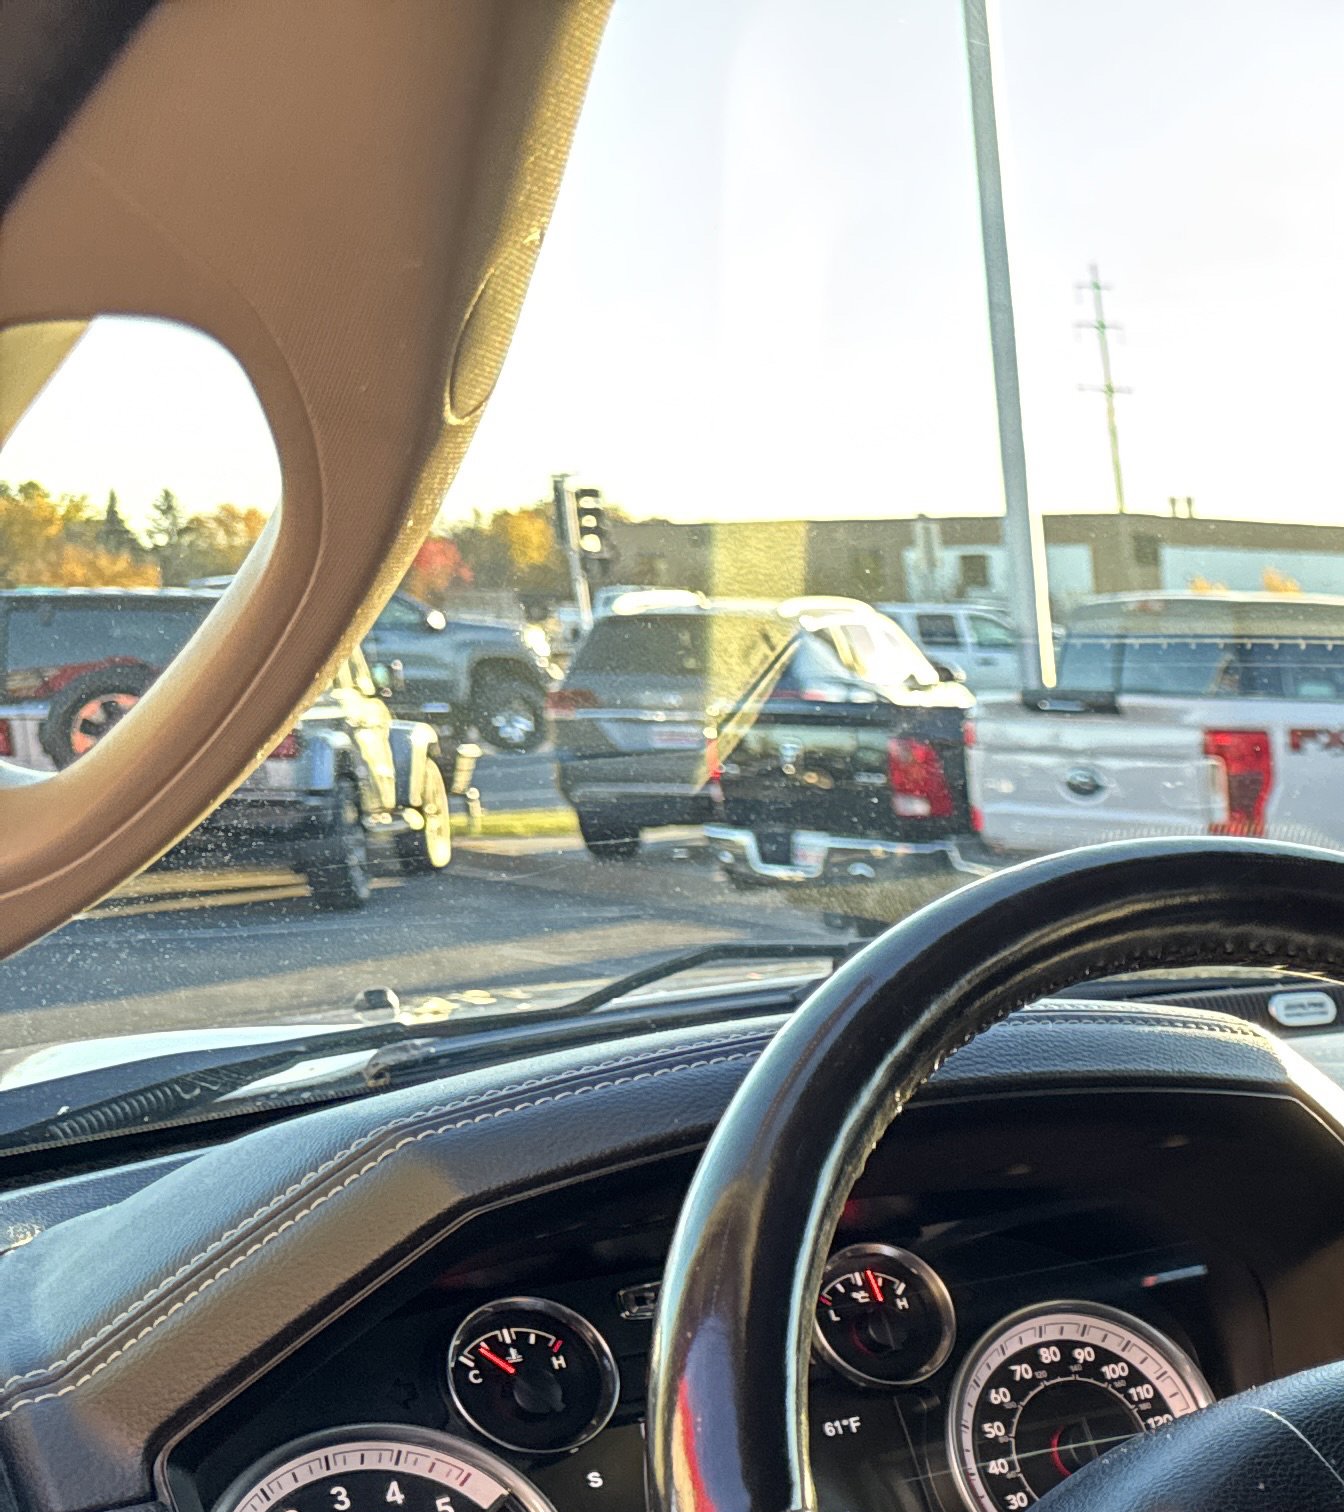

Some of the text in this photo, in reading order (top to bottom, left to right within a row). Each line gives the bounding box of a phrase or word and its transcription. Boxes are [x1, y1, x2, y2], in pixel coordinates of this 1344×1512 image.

[896, 1297, 909, 1310] H
[829, 1309, 841, 1321] L
[551, 1355, 567, 1370] H
[1039, 1346, 1061, 1364] 80
[1073, 1346, 1096, 1364] 90
[468, 1369, 483, 1384] C
[1010, 1363, 1033, 1381] 70
[1101, 1362, 1129, 1380] 100
[989, 1387, 1011, 1405] 60
[1127, 1383, 1154, 1401] 110
[824, 1416, 861, 1437] 61°F
[982, 1421, 1006, 1439] 50
[988, 1458, 1009, 1476] 40
[587, 1471, 603, 1488] S
[330, 1486, 351, 1511] 3
[386, 1480, 405, 1504] 4
[1006, 1492, 1028, 1510] 30
